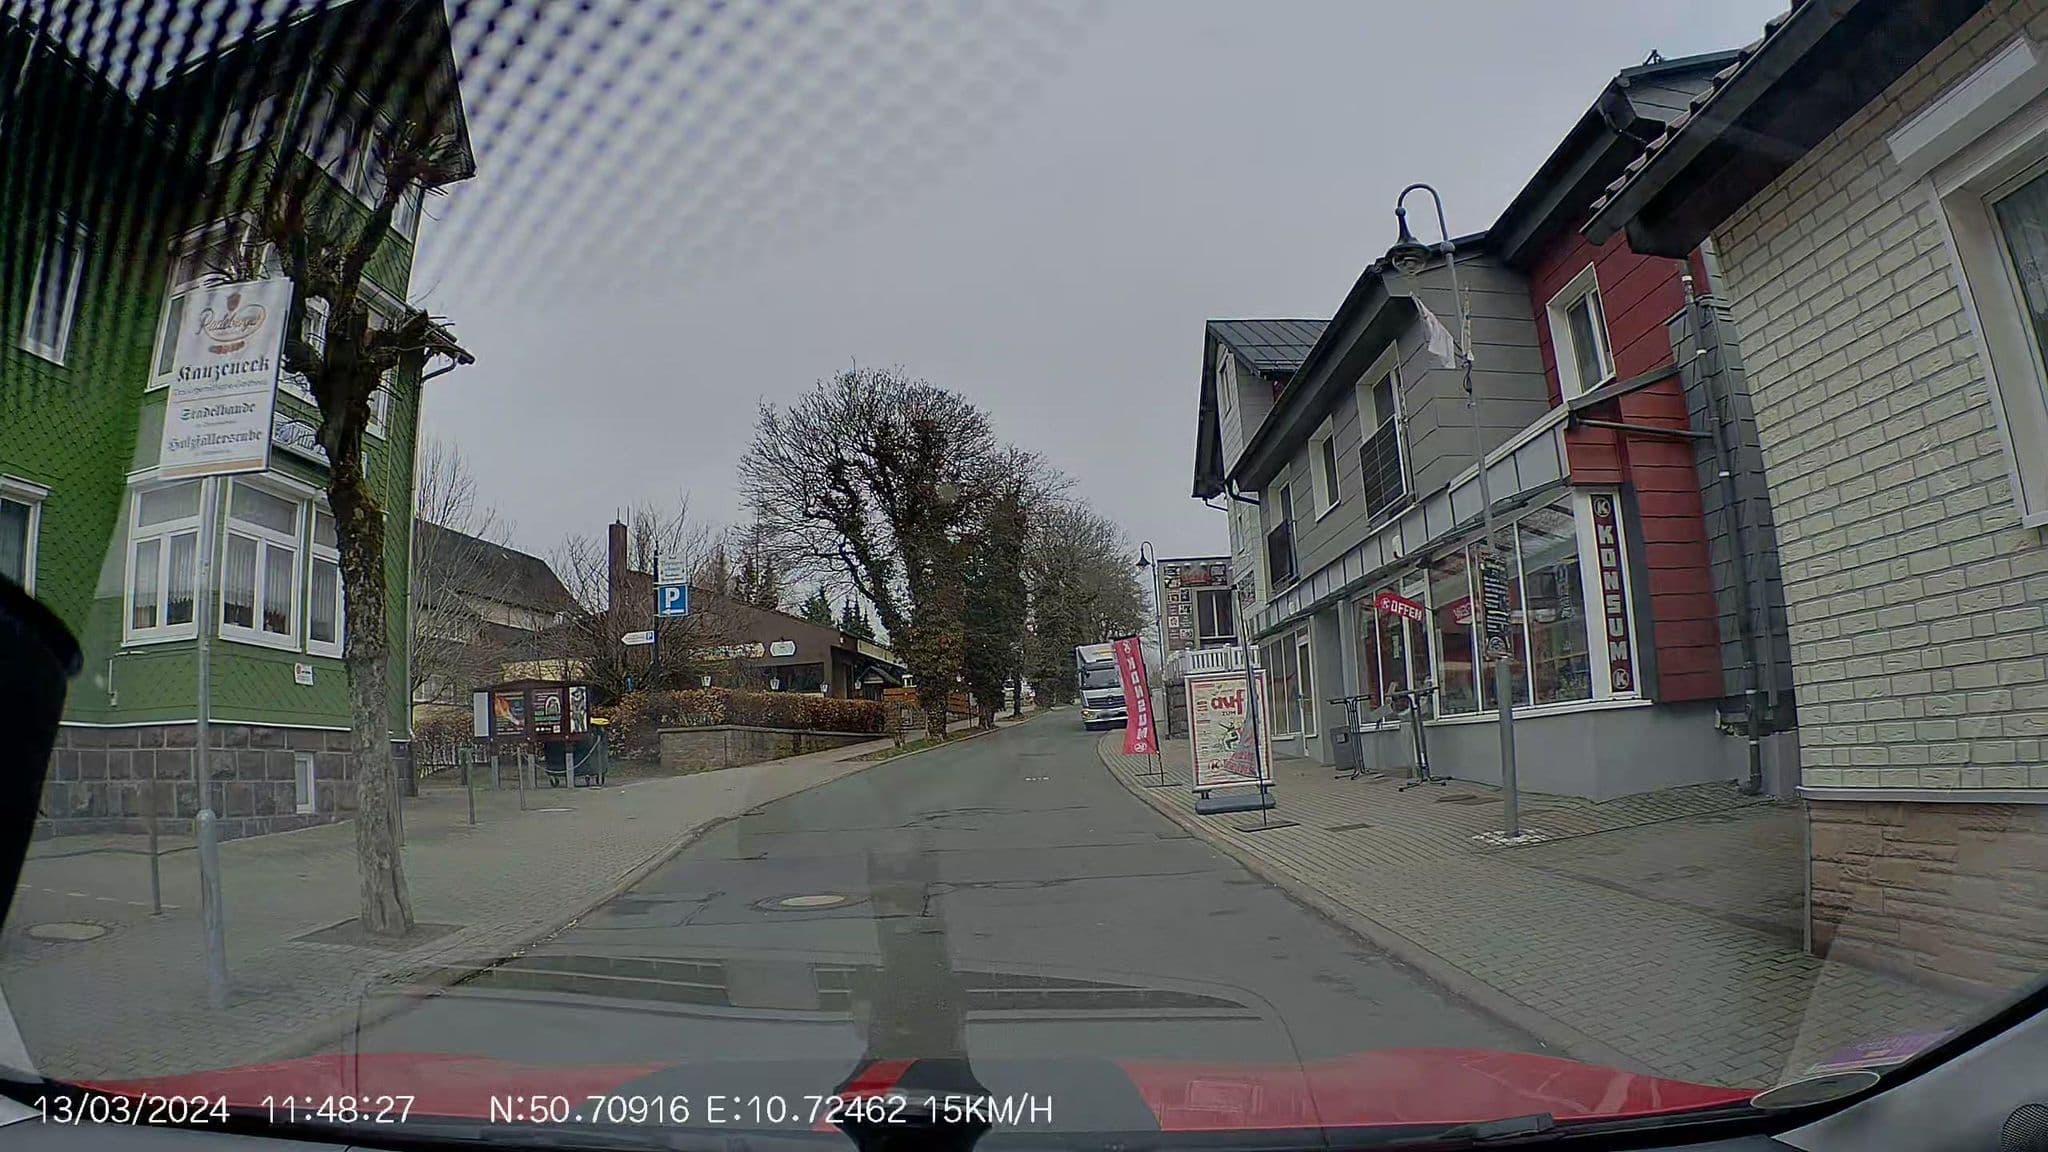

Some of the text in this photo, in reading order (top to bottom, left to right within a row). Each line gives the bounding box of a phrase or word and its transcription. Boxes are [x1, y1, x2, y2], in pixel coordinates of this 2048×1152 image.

[665, 587, 681, 609] P
[1598, 525, 1628, 661] KONSUM
[1390, 601, 1423, 622] OFFEN
[1211, 689, 1246, 715] auf
